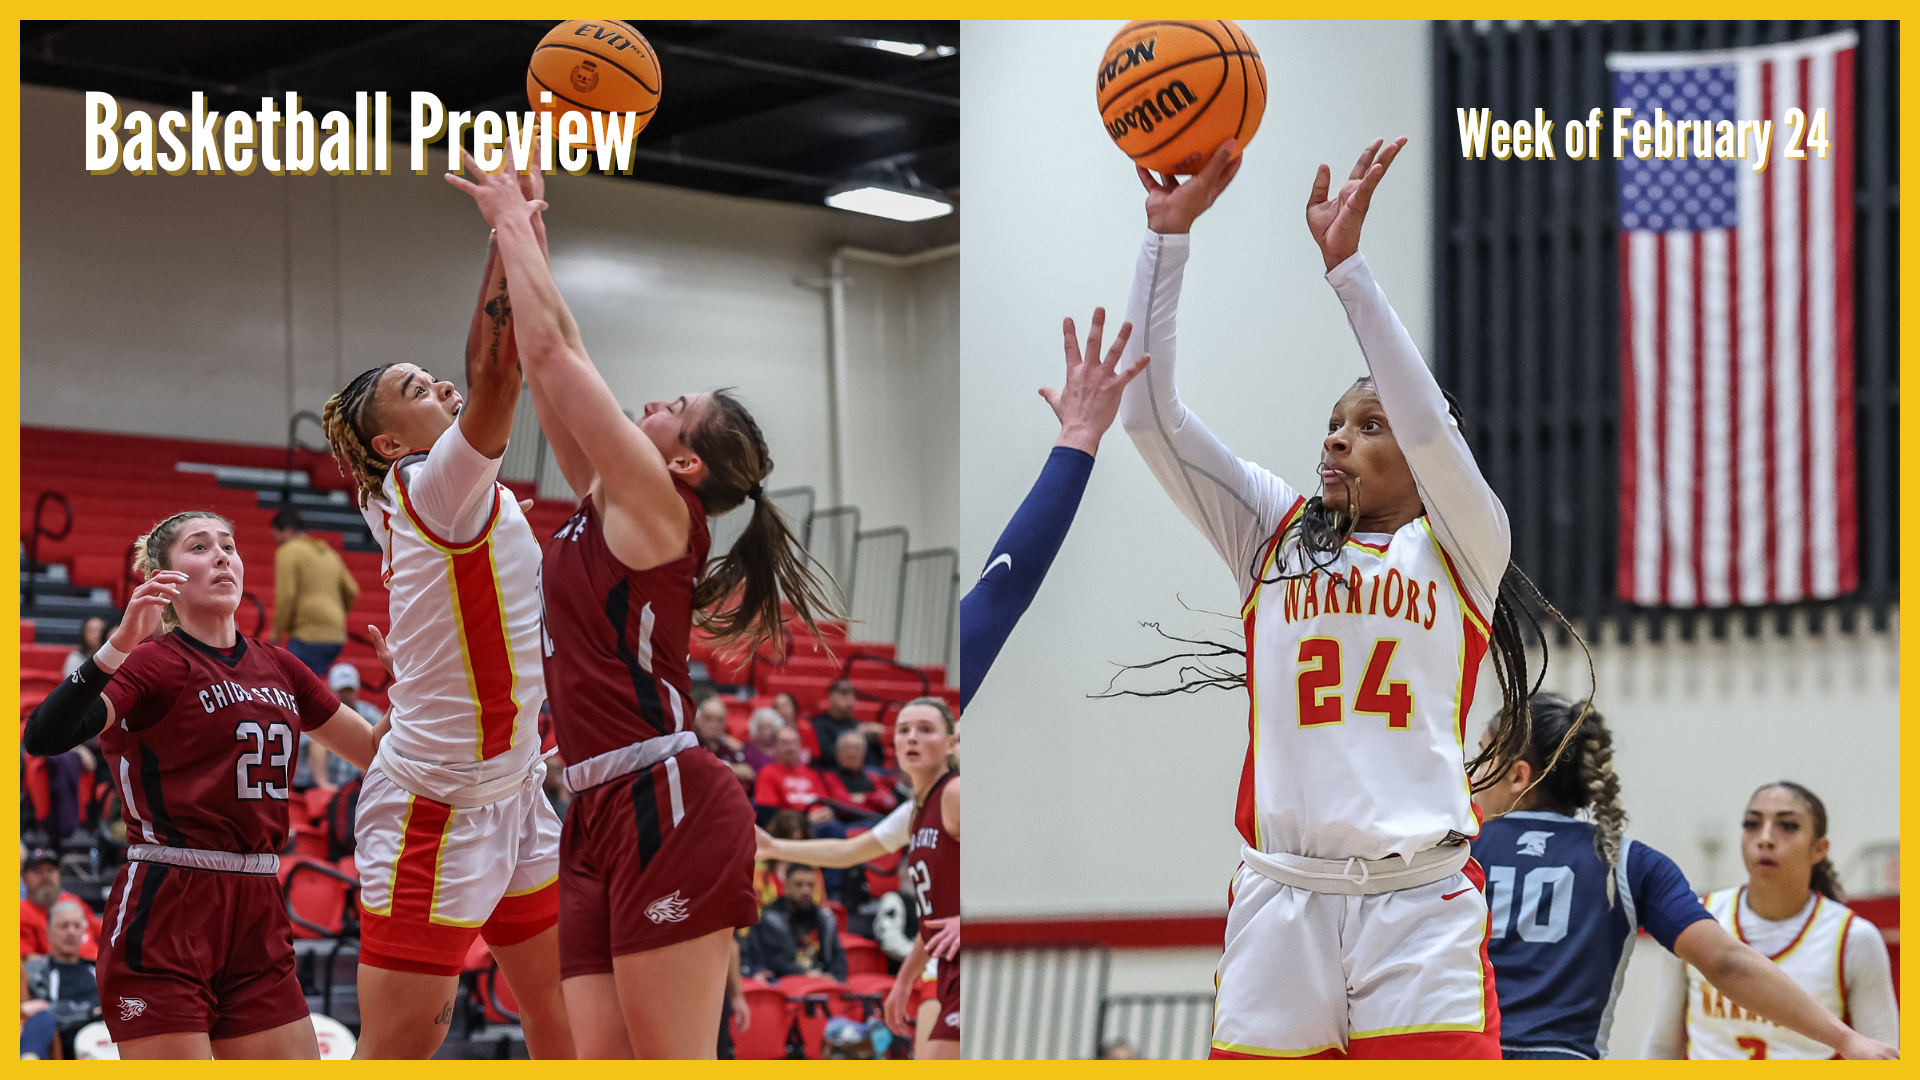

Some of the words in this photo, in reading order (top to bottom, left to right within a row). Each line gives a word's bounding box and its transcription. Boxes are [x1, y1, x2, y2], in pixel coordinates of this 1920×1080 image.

[574, 23, 632, 51] EVO
[1106, 79, 1198, 141] Wilson
[1283, 565, 1438, 631] WARRIORS
[250, 686, 300, 716] STATE
[1296, 635, 1415, 732] 24
[235, 720, 293, 802] 23
[1488, 865, 1575, 943] 10
